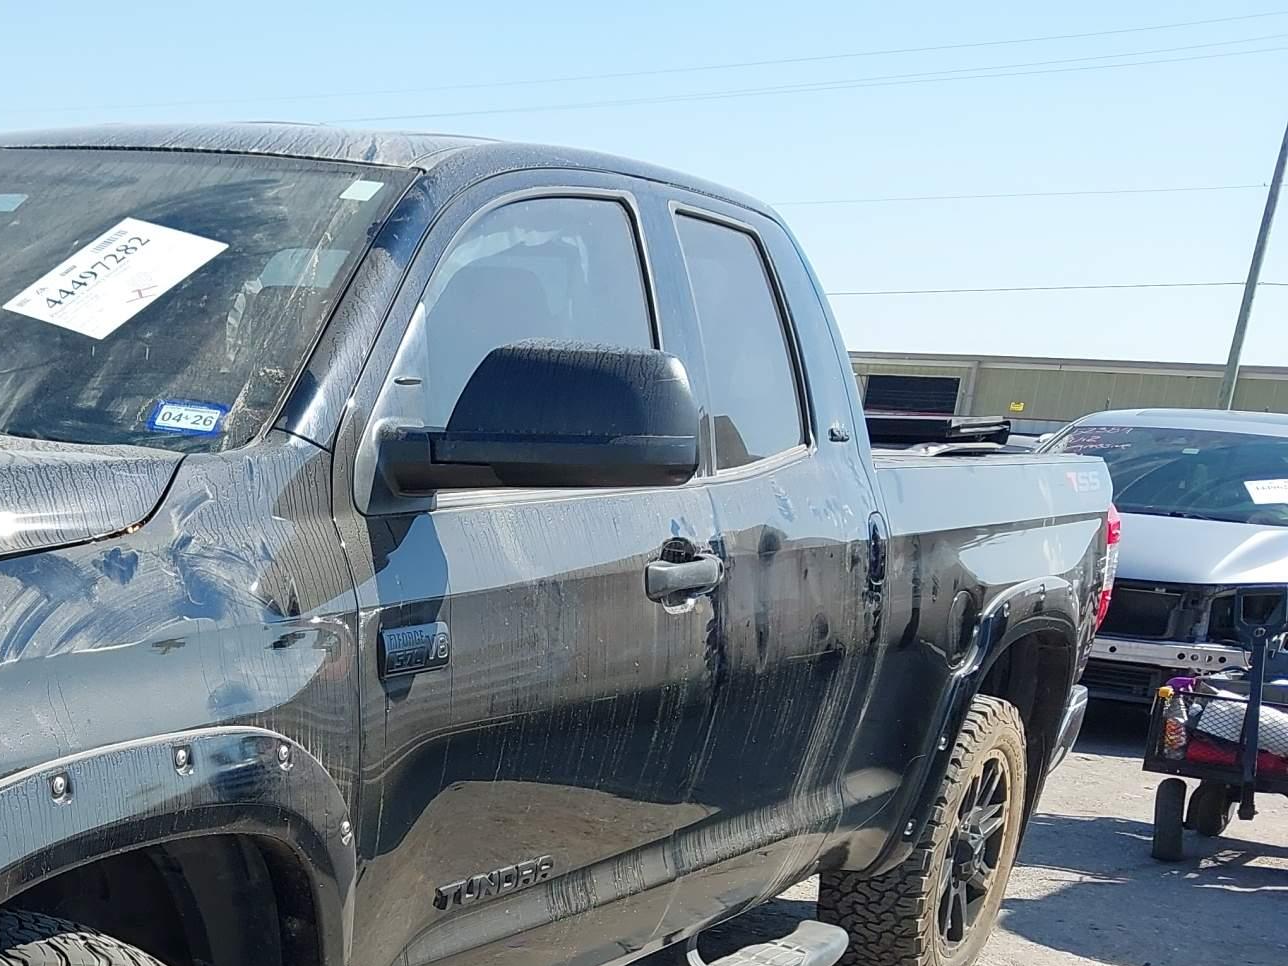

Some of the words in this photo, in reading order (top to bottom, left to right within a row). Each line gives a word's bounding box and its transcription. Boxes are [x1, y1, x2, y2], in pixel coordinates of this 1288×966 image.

[44, 236, 152, 309] 44497282
[161, 411, 184, 423] 04
[191, 414, 215, 427] 26
[424, 632, 449, 660] V8
[432, 854, 554, 911] TUNDRA
